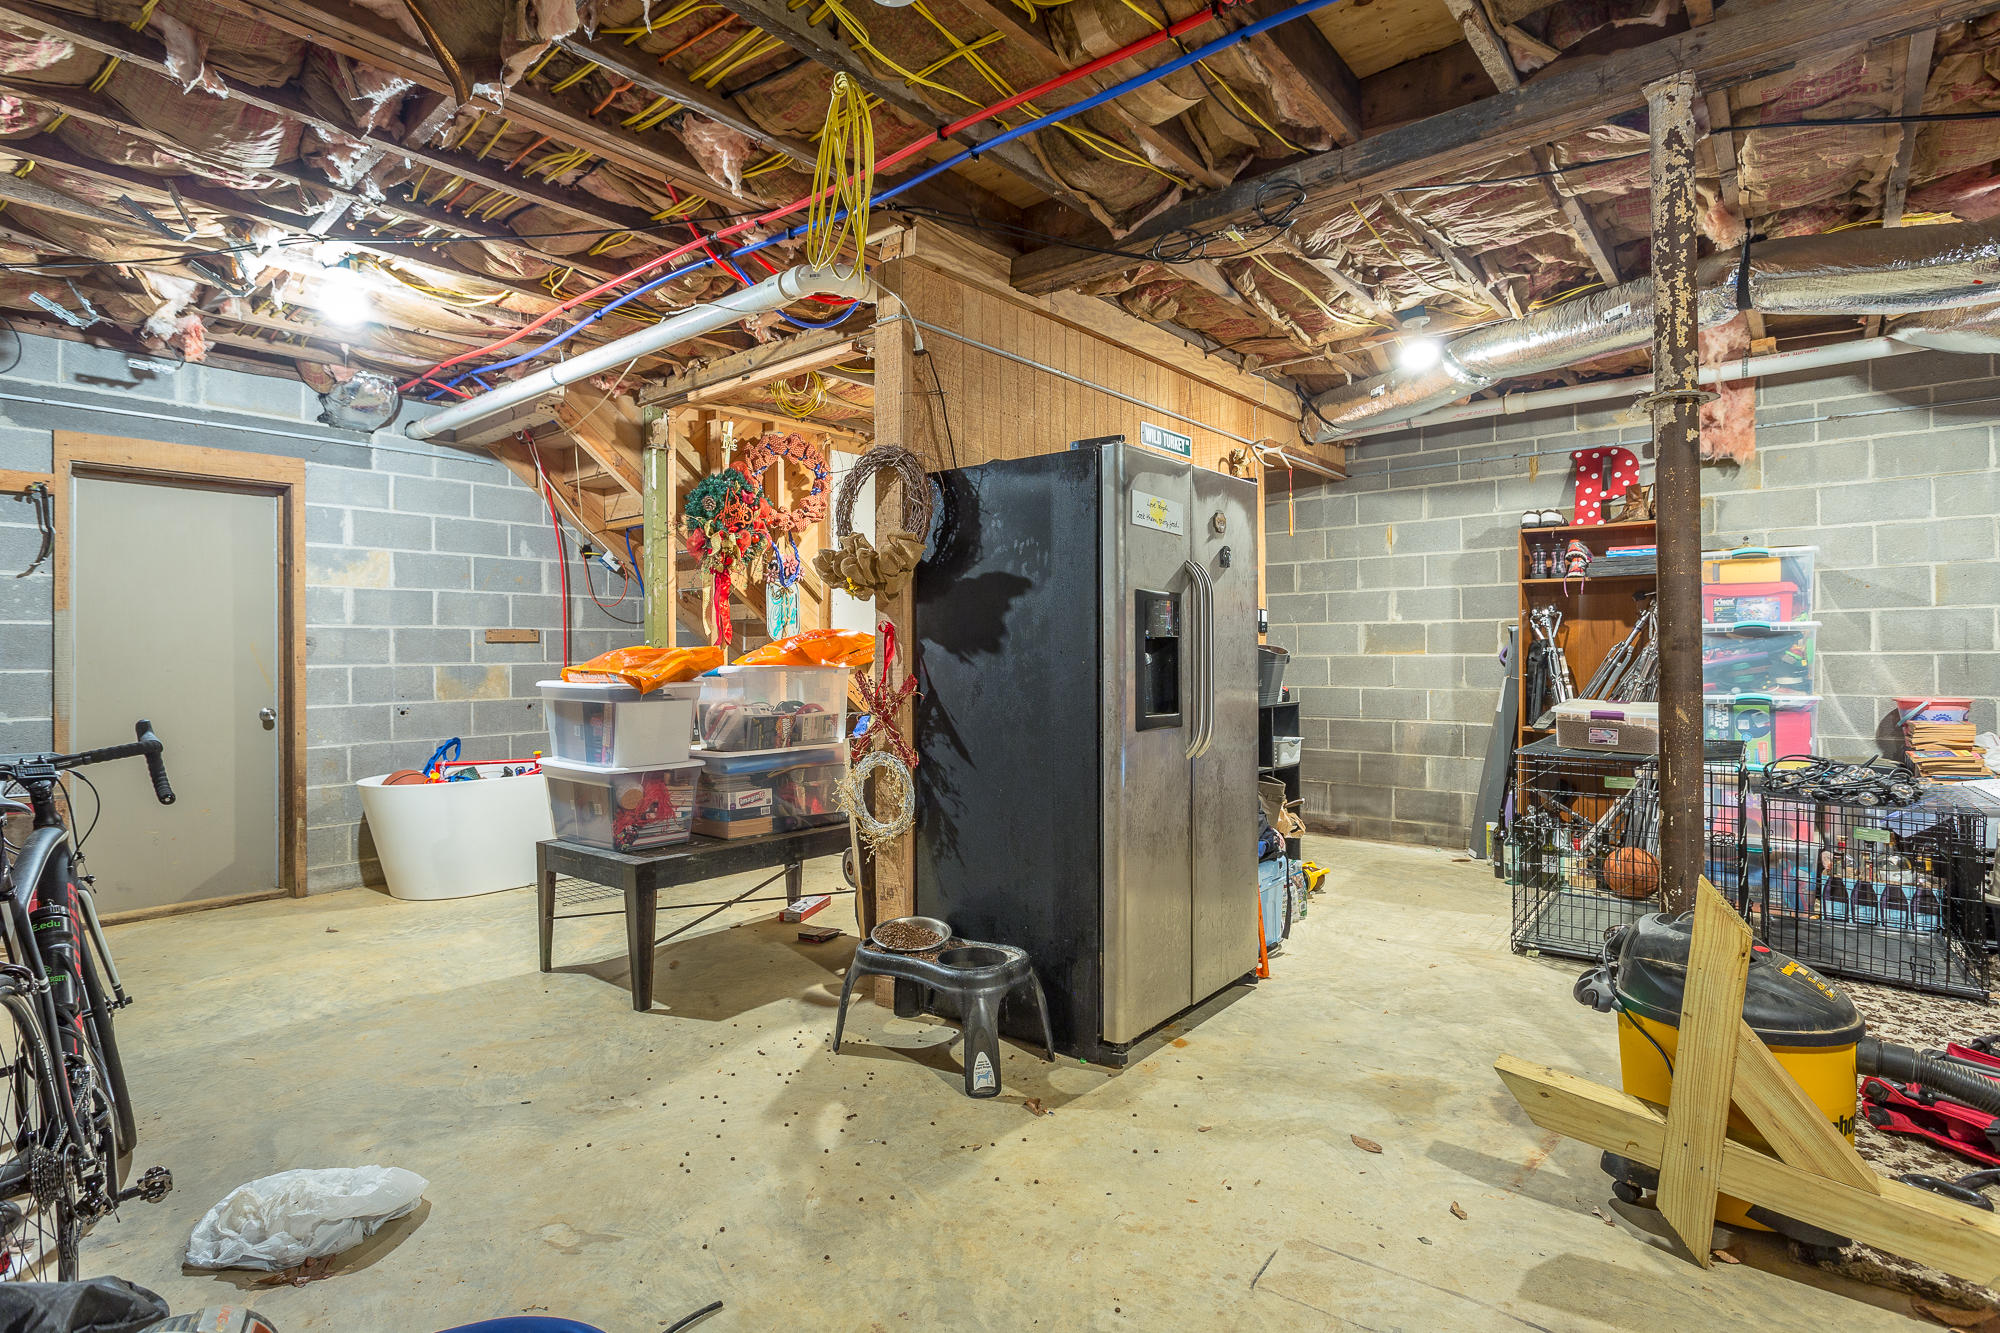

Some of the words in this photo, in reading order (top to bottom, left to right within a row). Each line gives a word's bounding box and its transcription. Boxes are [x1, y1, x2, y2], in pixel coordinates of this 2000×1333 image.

[1144, 426, 1162, 446] WILD
[1163, 432, 1186, 453] TURKEY
[1569, 446, 1640, 526] P
